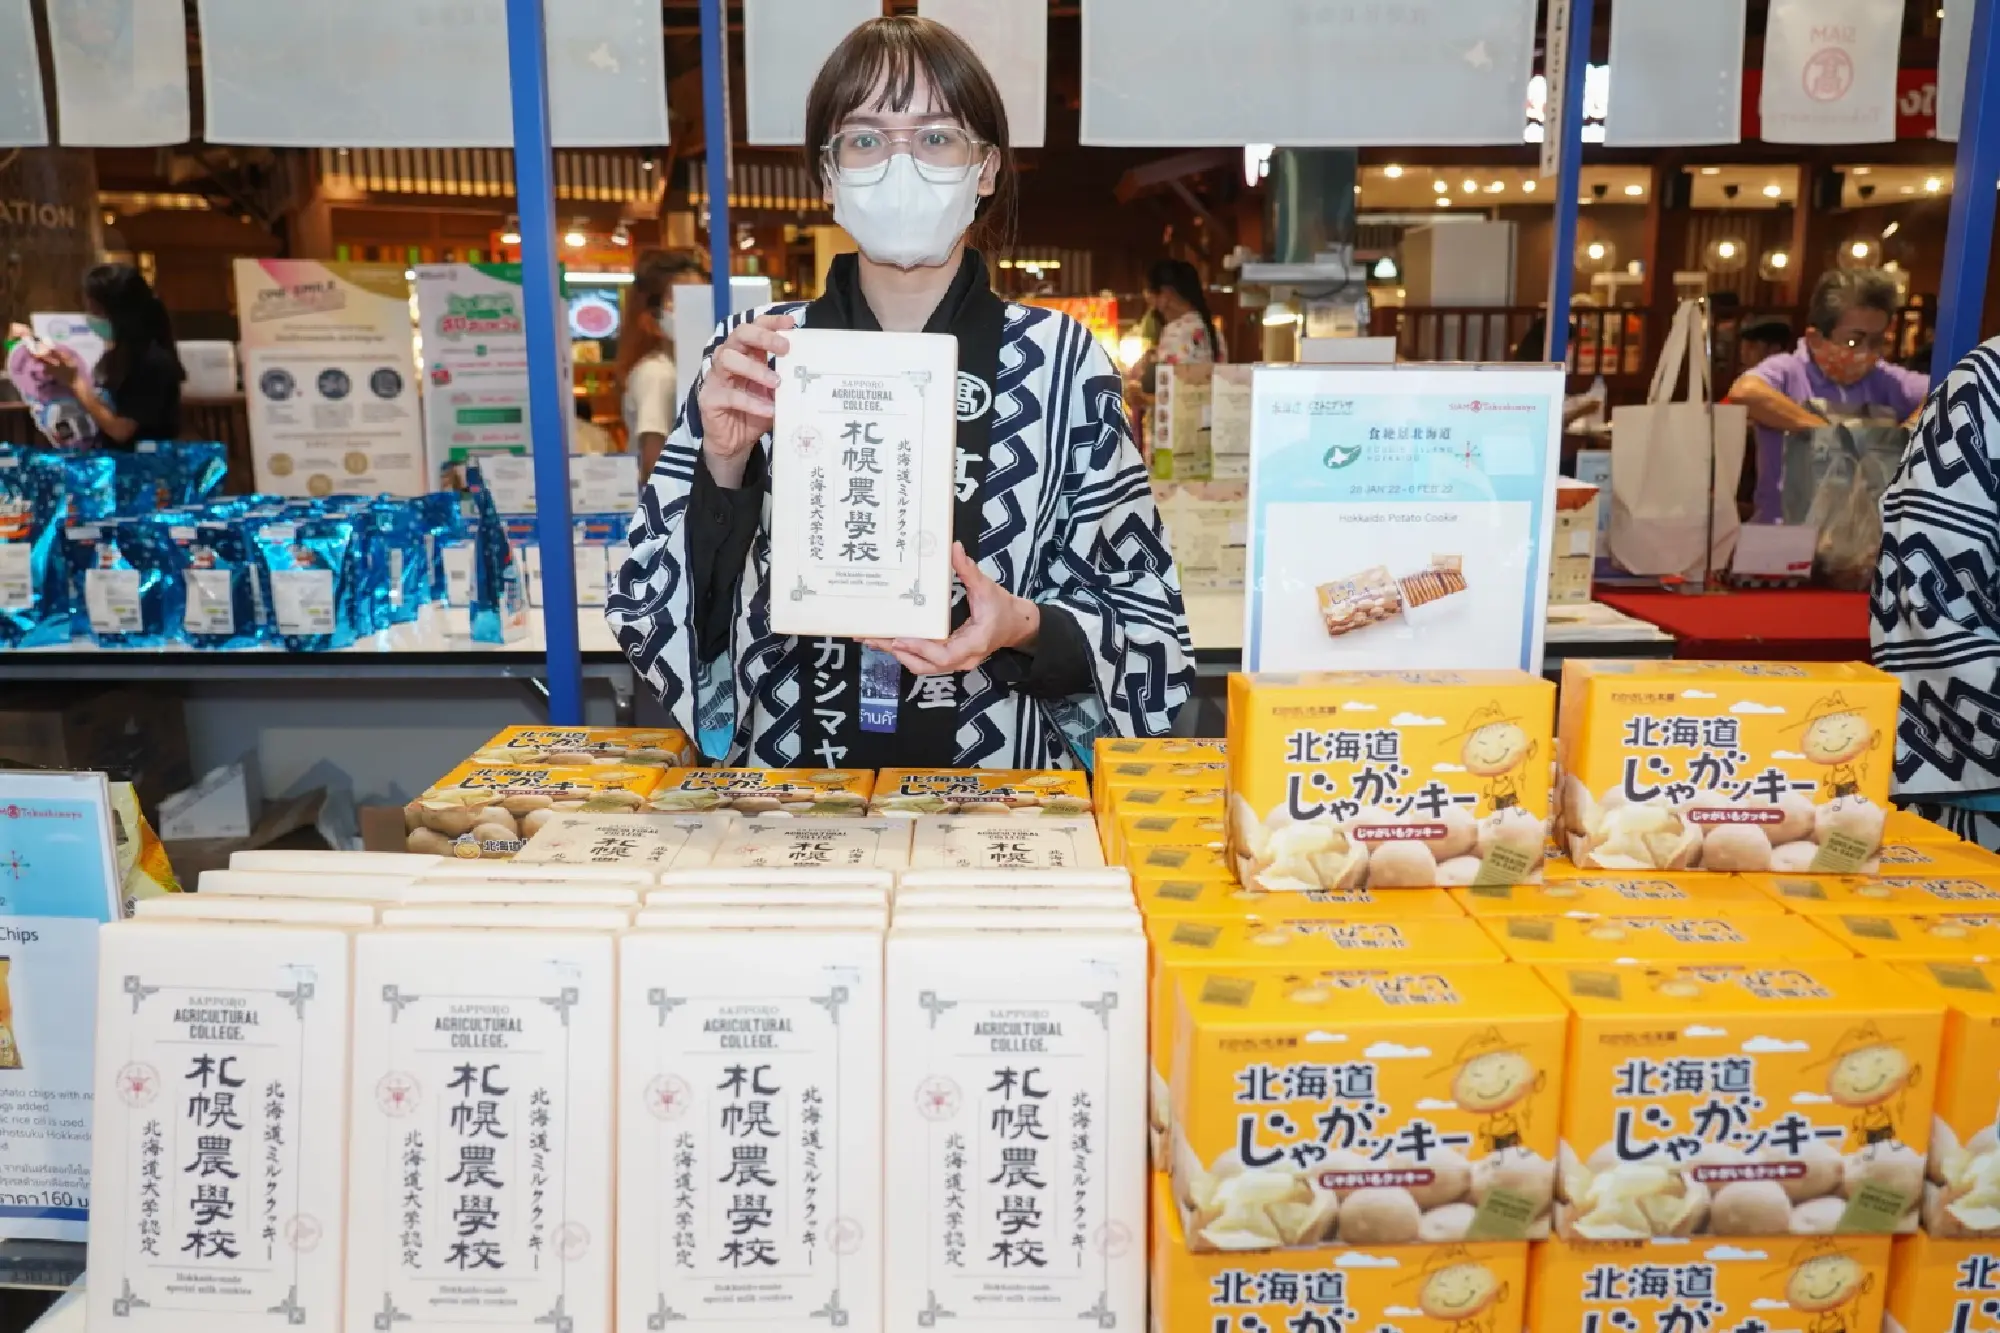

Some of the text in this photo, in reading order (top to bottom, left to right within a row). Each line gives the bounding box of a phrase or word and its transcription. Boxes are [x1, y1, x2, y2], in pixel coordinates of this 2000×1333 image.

[832, 389, 894, 401] AGRICULTURAL
[839, 420, 885, 562] 札幌農學校
[1388, 514, 1422, 523] Potato
[1425, 513, 1458, 523] Cookie
[1287, 730, 1399, 763] 北海道
[1625, 716, 1738, 748] 北海道
[1288, 763, 1476, 823] じゃがッキー
[1625, 750, 1815, 804] じゃがッキー
[1692, 810, 1781, 822] じゃがいもクッキー
[173, 1008, 260, 1026] AGRICULTURAL
[189, 997, 246, 1008] SAPPORO
[434, 1017, 523, 1032] AGRICULTURAL
[703, 1018, 793, 1032] AGRICULTURAL
[973, 1022, 1063, 1037] AGRICULTURAL
[1237, 1064, 1375, 1101] 北海道
[1616, 1058, 1751, 1095] 北海道
[29, 1088, 56, 1100] chips
[1241, 1103, 1470, 1168] じゃがッキー
[1616, 1096, 1843, 1161] じゃがッキー
[181, 1053, 246, 1259] 札幌農學校
[444, 1062, 509, 1271] 札幌農學校
[716, 1064, 781, 1268] 札幌農學校
[986, 1066, 1051, 1268] 札幌農學校
[1213, 1271, 1345, 1305] 北海道
[1585, 1265, 1714, 1300] 北海道
